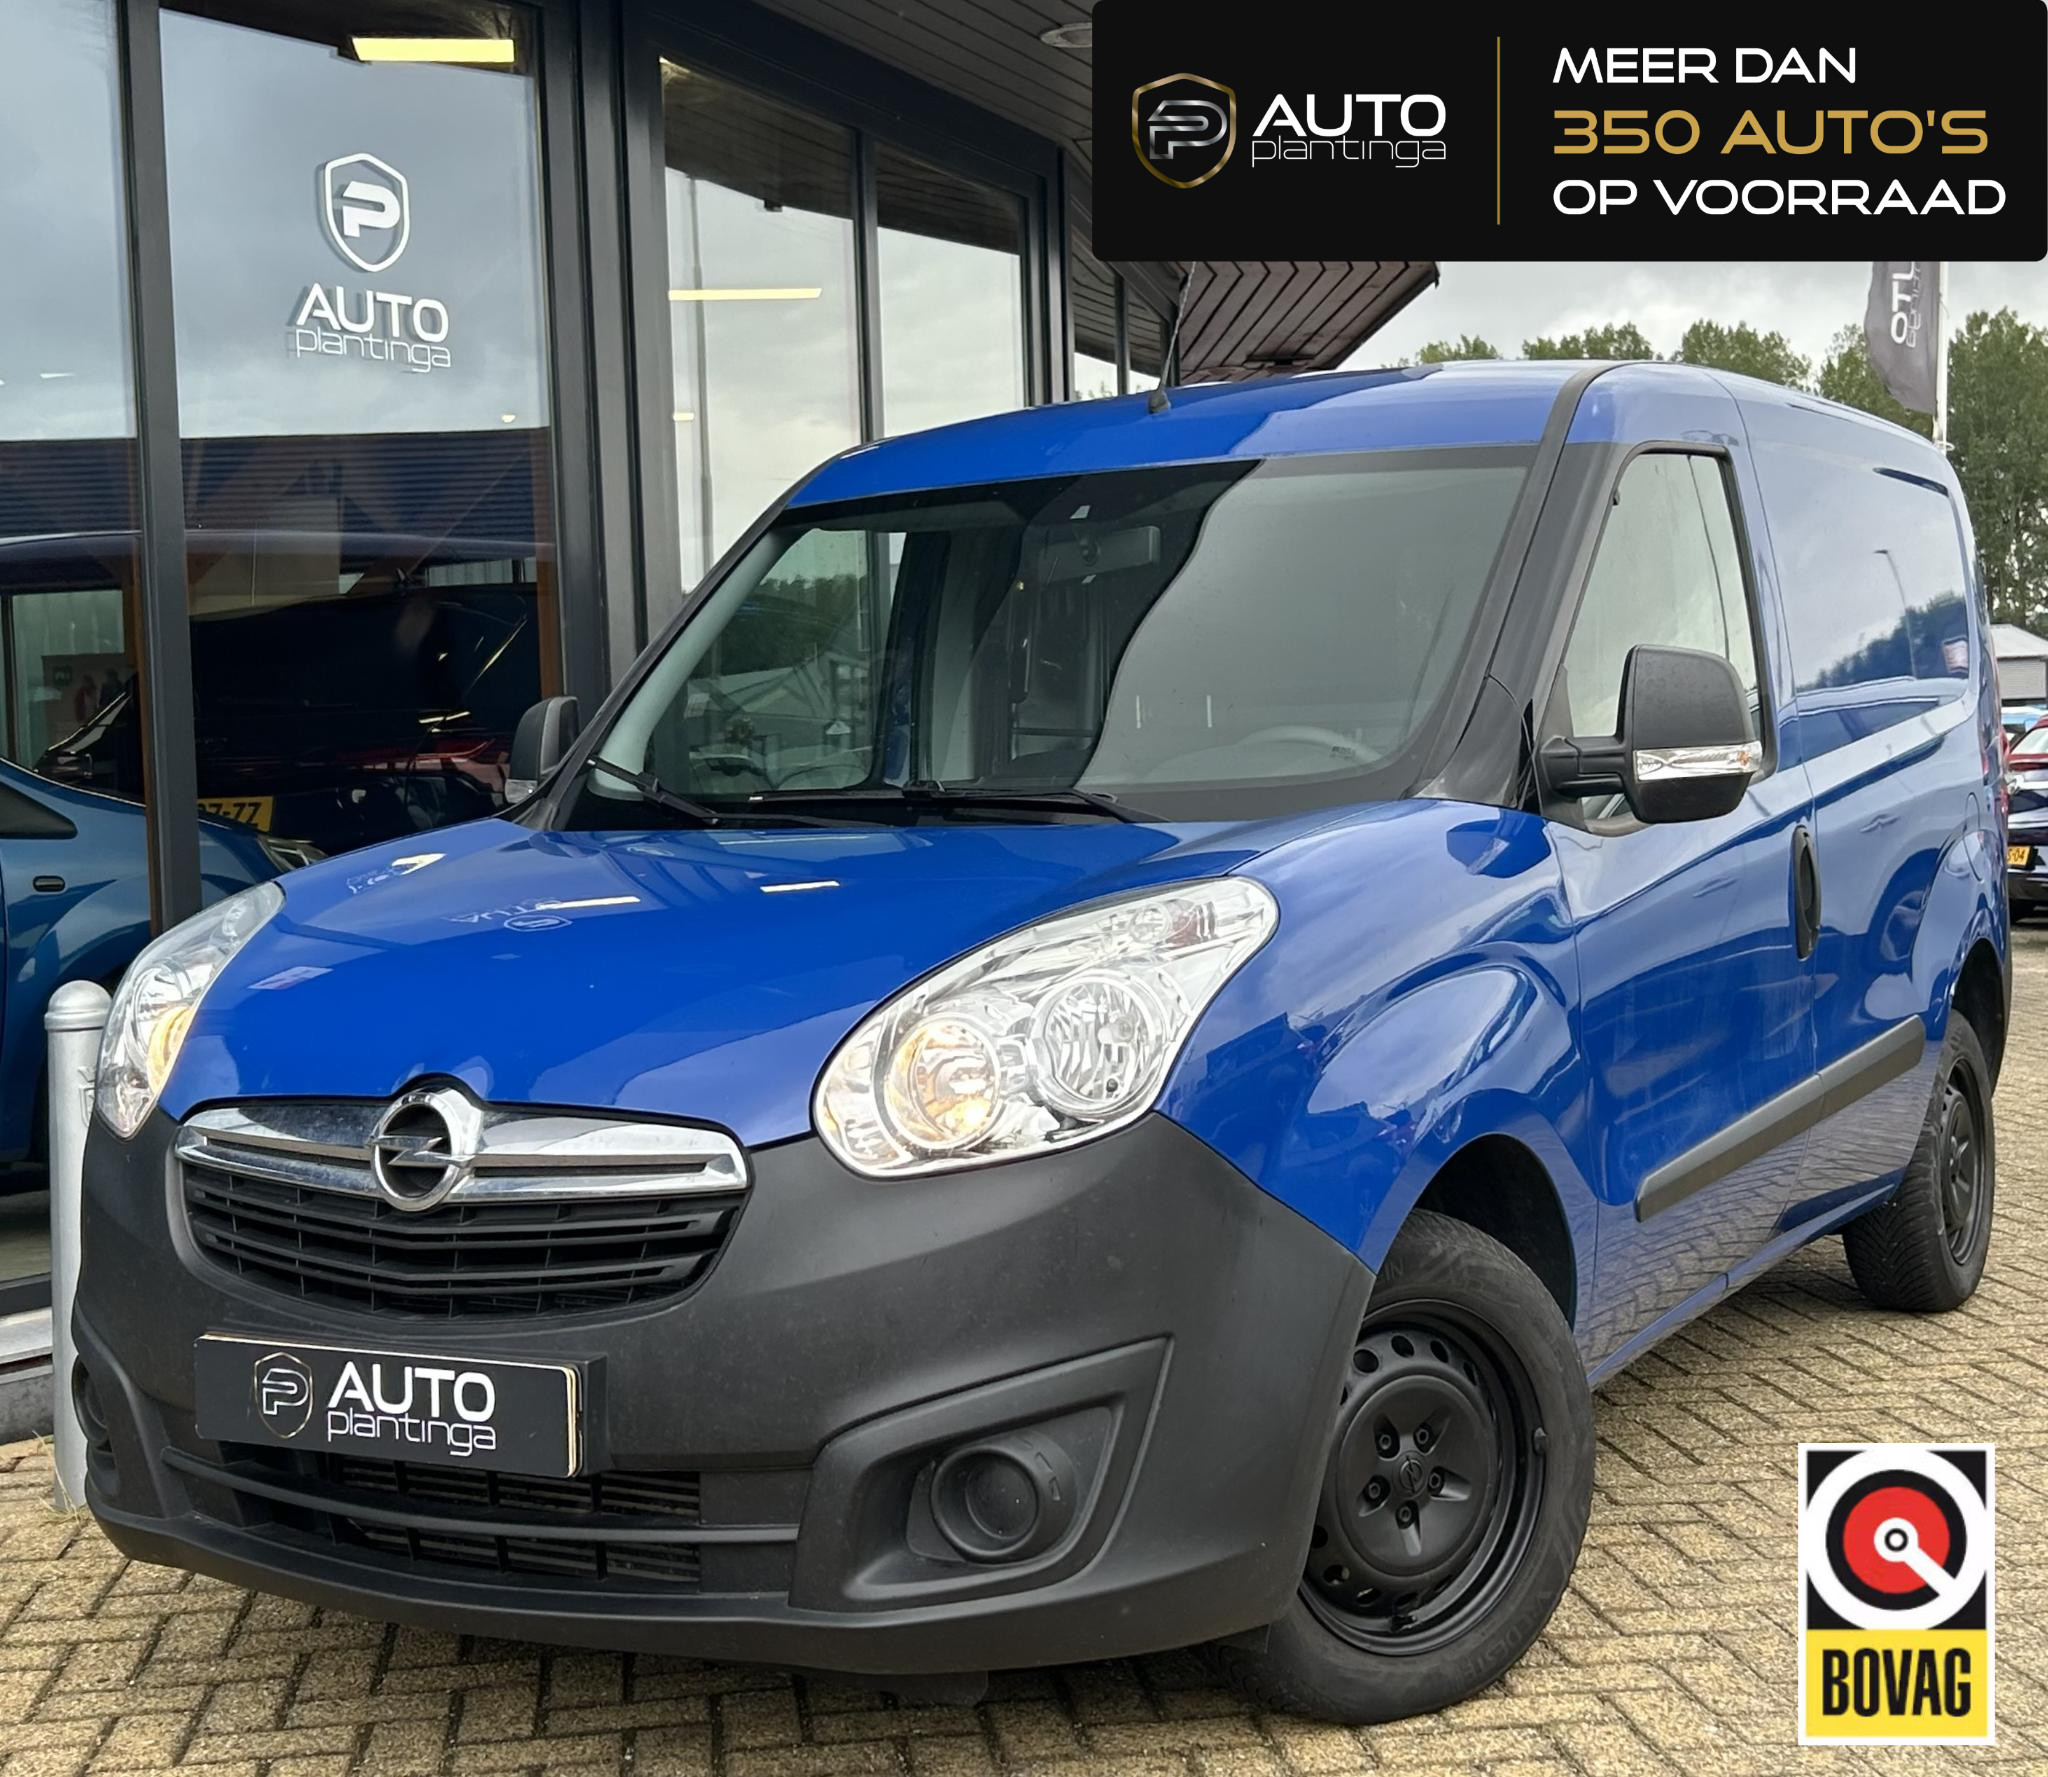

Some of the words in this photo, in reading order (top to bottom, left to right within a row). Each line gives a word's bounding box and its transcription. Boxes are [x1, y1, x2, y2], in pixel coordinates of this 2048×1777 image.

[296, 283, 449, 343] AUTO
[295, 326, 451, 373] plantinga
[328, 1361, 497, 1423] AUTO
[327, 1408, 497, 1456] plantinga
